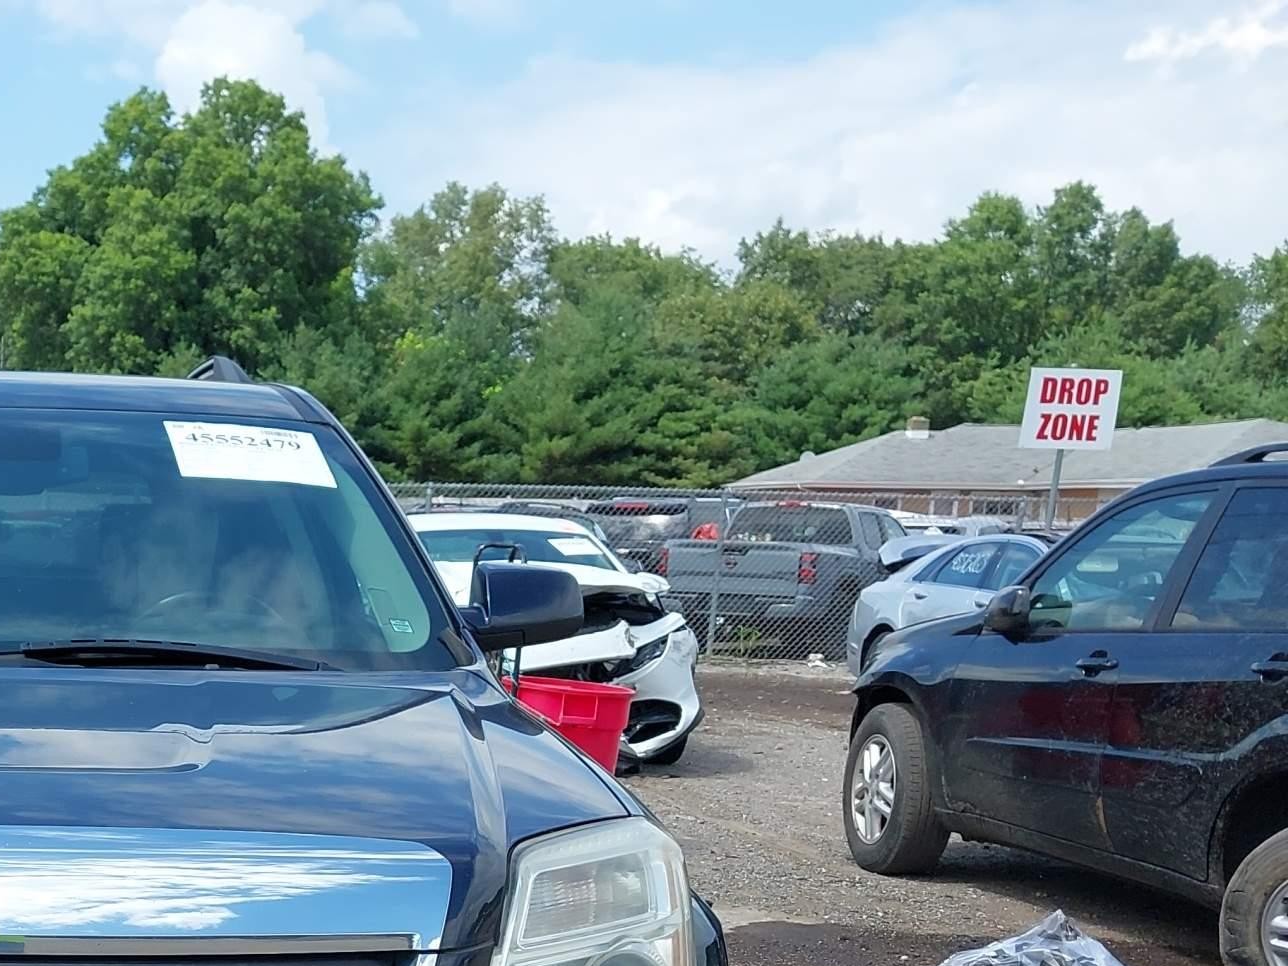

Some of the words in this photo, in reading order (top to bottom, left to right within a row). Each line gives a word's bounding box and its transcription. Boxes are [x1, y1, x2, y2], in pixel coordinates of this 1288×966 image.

[1039, 376, 1110, 405] DROP
[184, 431, 302, 451] 45552479
[1036, 413, 1100, 441] ZONE
